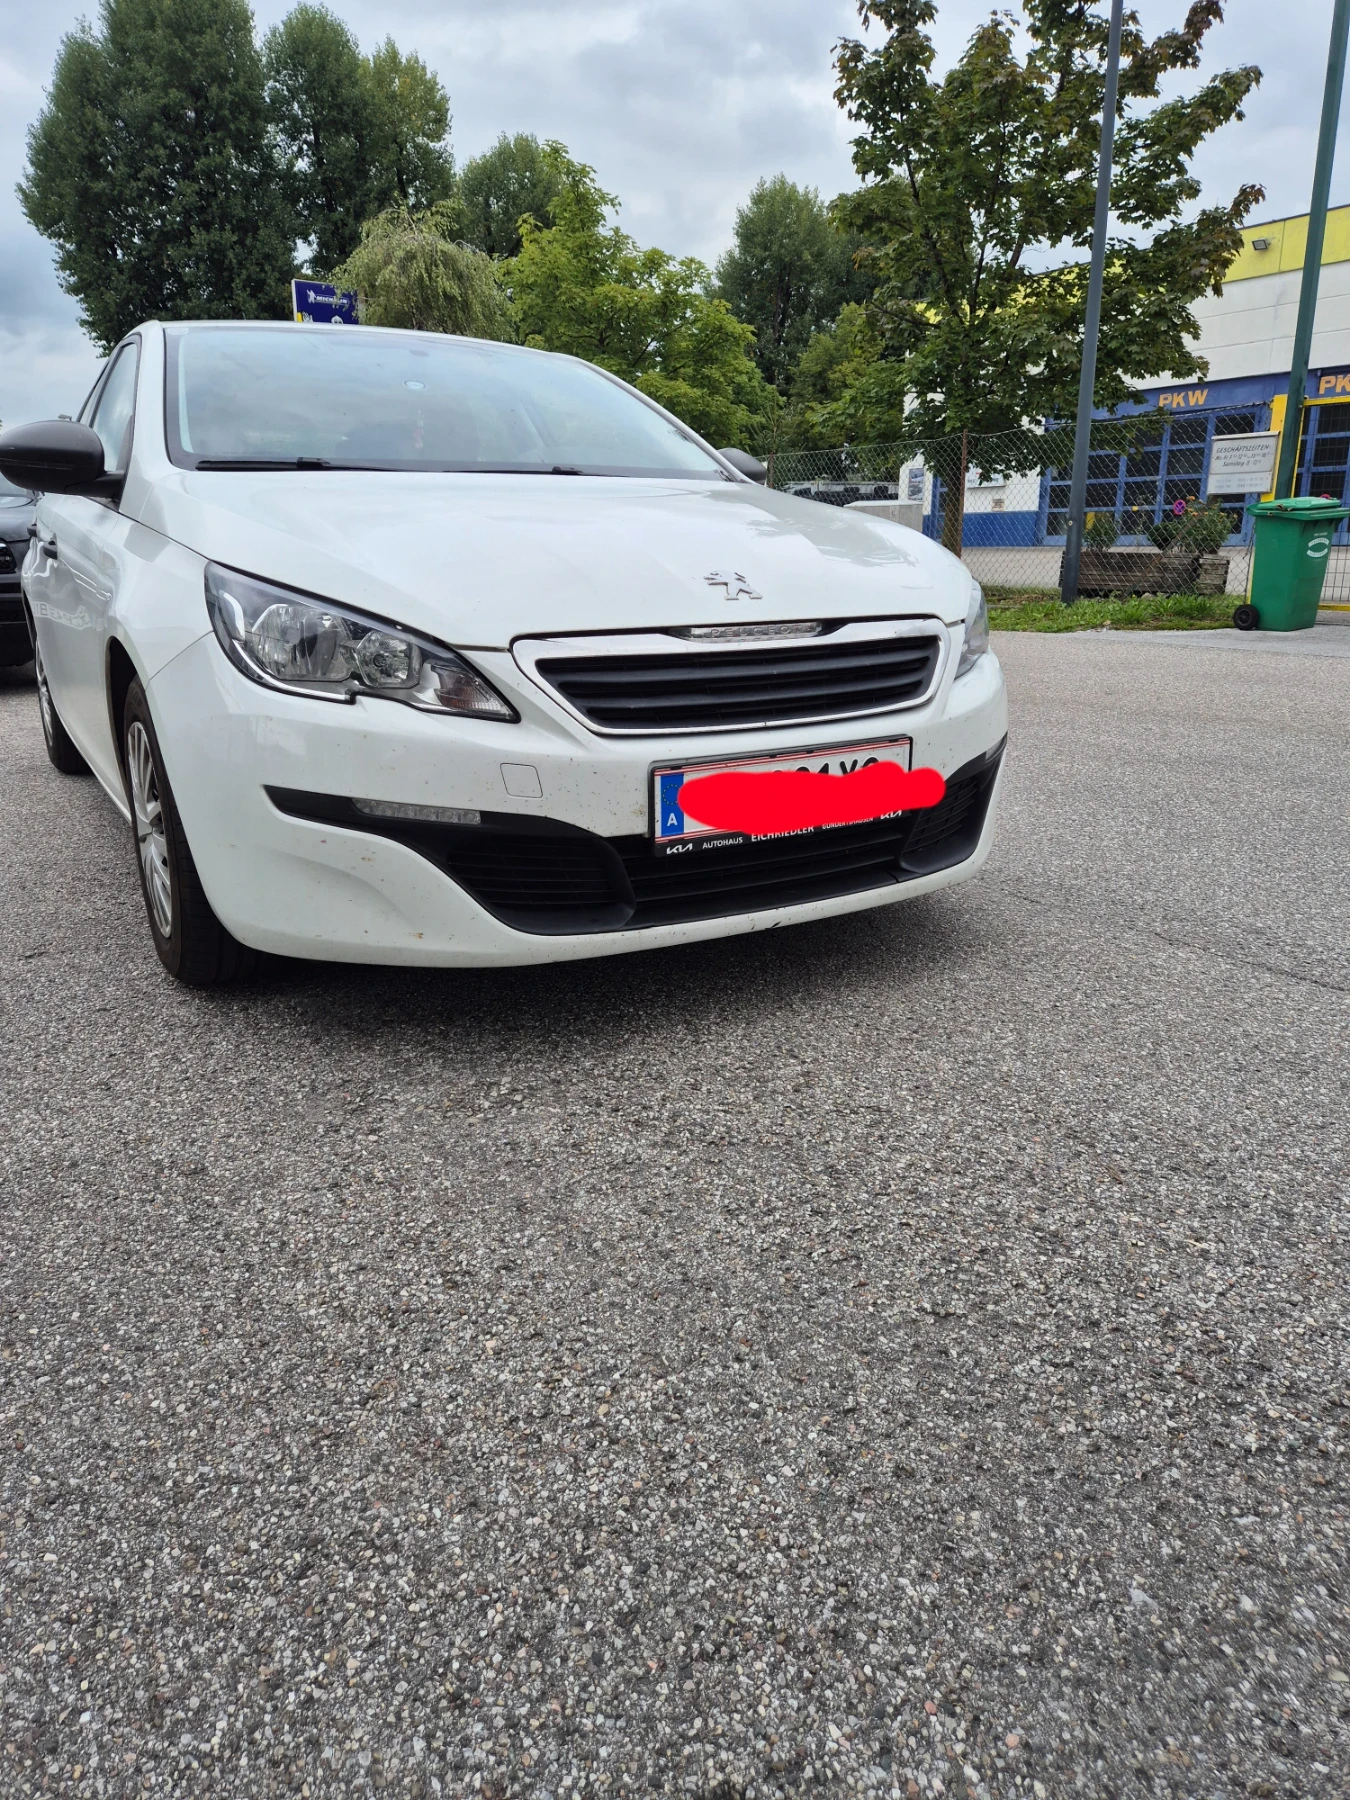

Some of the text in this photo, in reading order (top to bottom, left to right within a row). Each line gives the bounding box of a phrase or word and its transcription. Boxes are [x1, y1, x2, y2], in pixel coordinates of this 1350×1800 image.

[316, 295, 348, 304] MICHIN
[1158, 388, 1209, 409] PKW
[710, 625, 802, 638] PEUGEOT
[666, 813, 678, 827] A
[702, 836, 744, 849] AUTOHAUS
